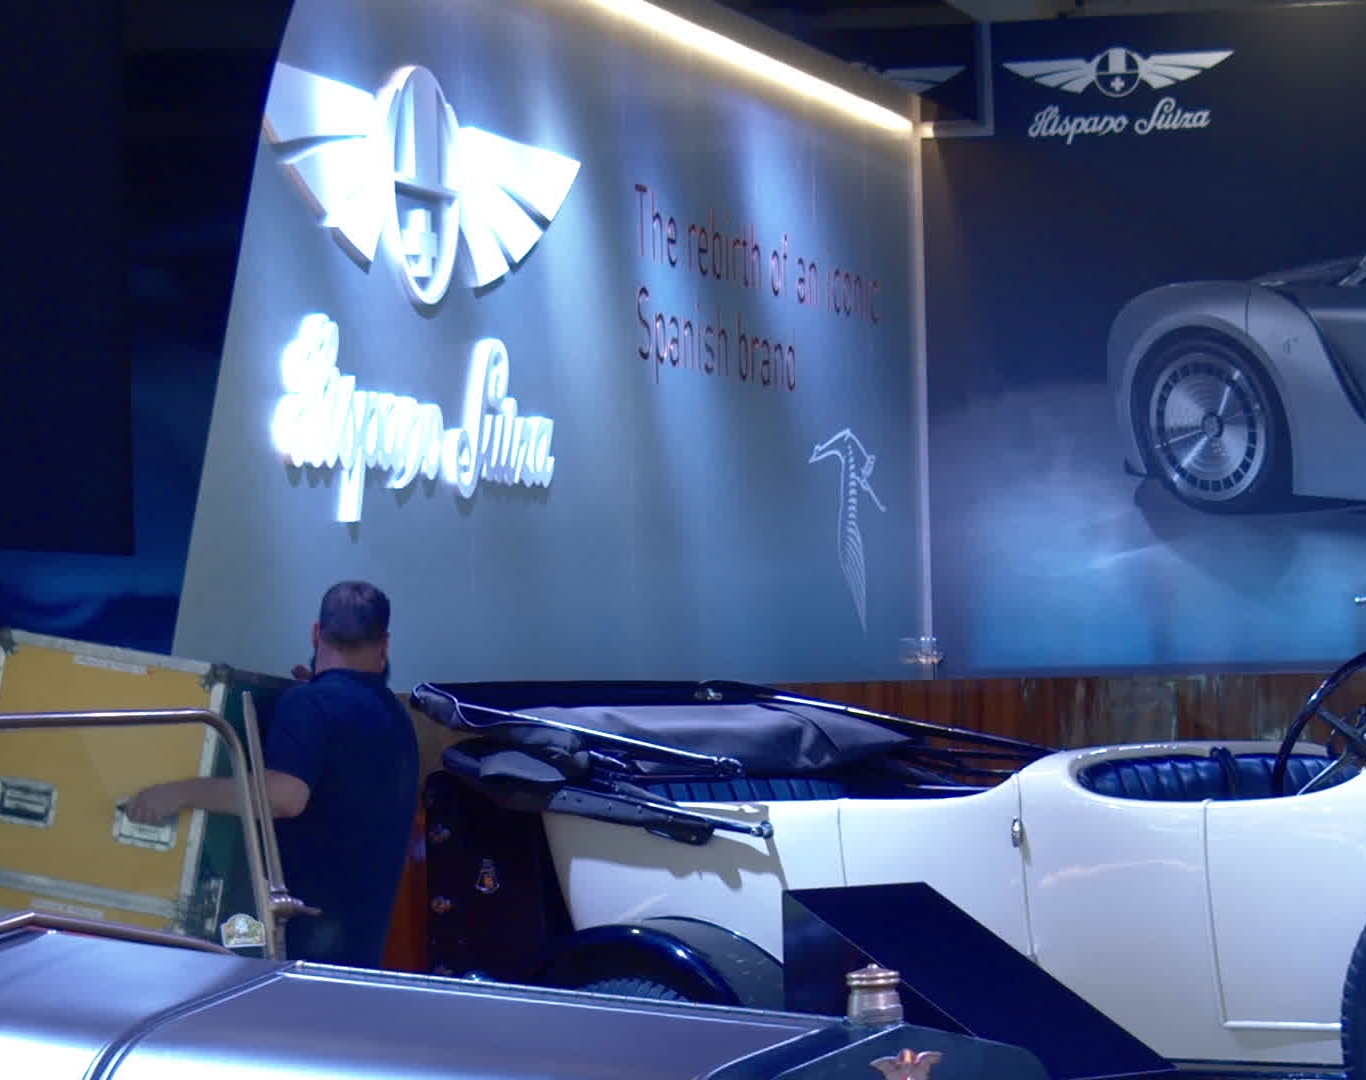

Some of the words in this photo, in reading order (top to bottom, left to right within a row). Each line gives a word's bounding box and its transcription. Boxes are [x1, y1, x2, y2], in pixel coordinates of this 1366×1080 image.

[1028, 104, 1129, 145] Hispano
[1134, 96, 1211, 136] Suiza
[635, 183, 679, 268] The
[688, 206, 762, 291] rebirth
[770, 231, 790, 298] of
[796, 256, 819, 305] an
[827, 250, 881, 326] iconic
[637, 285, 730, 386] Spanish
[736, 310, 797, 392] brand
